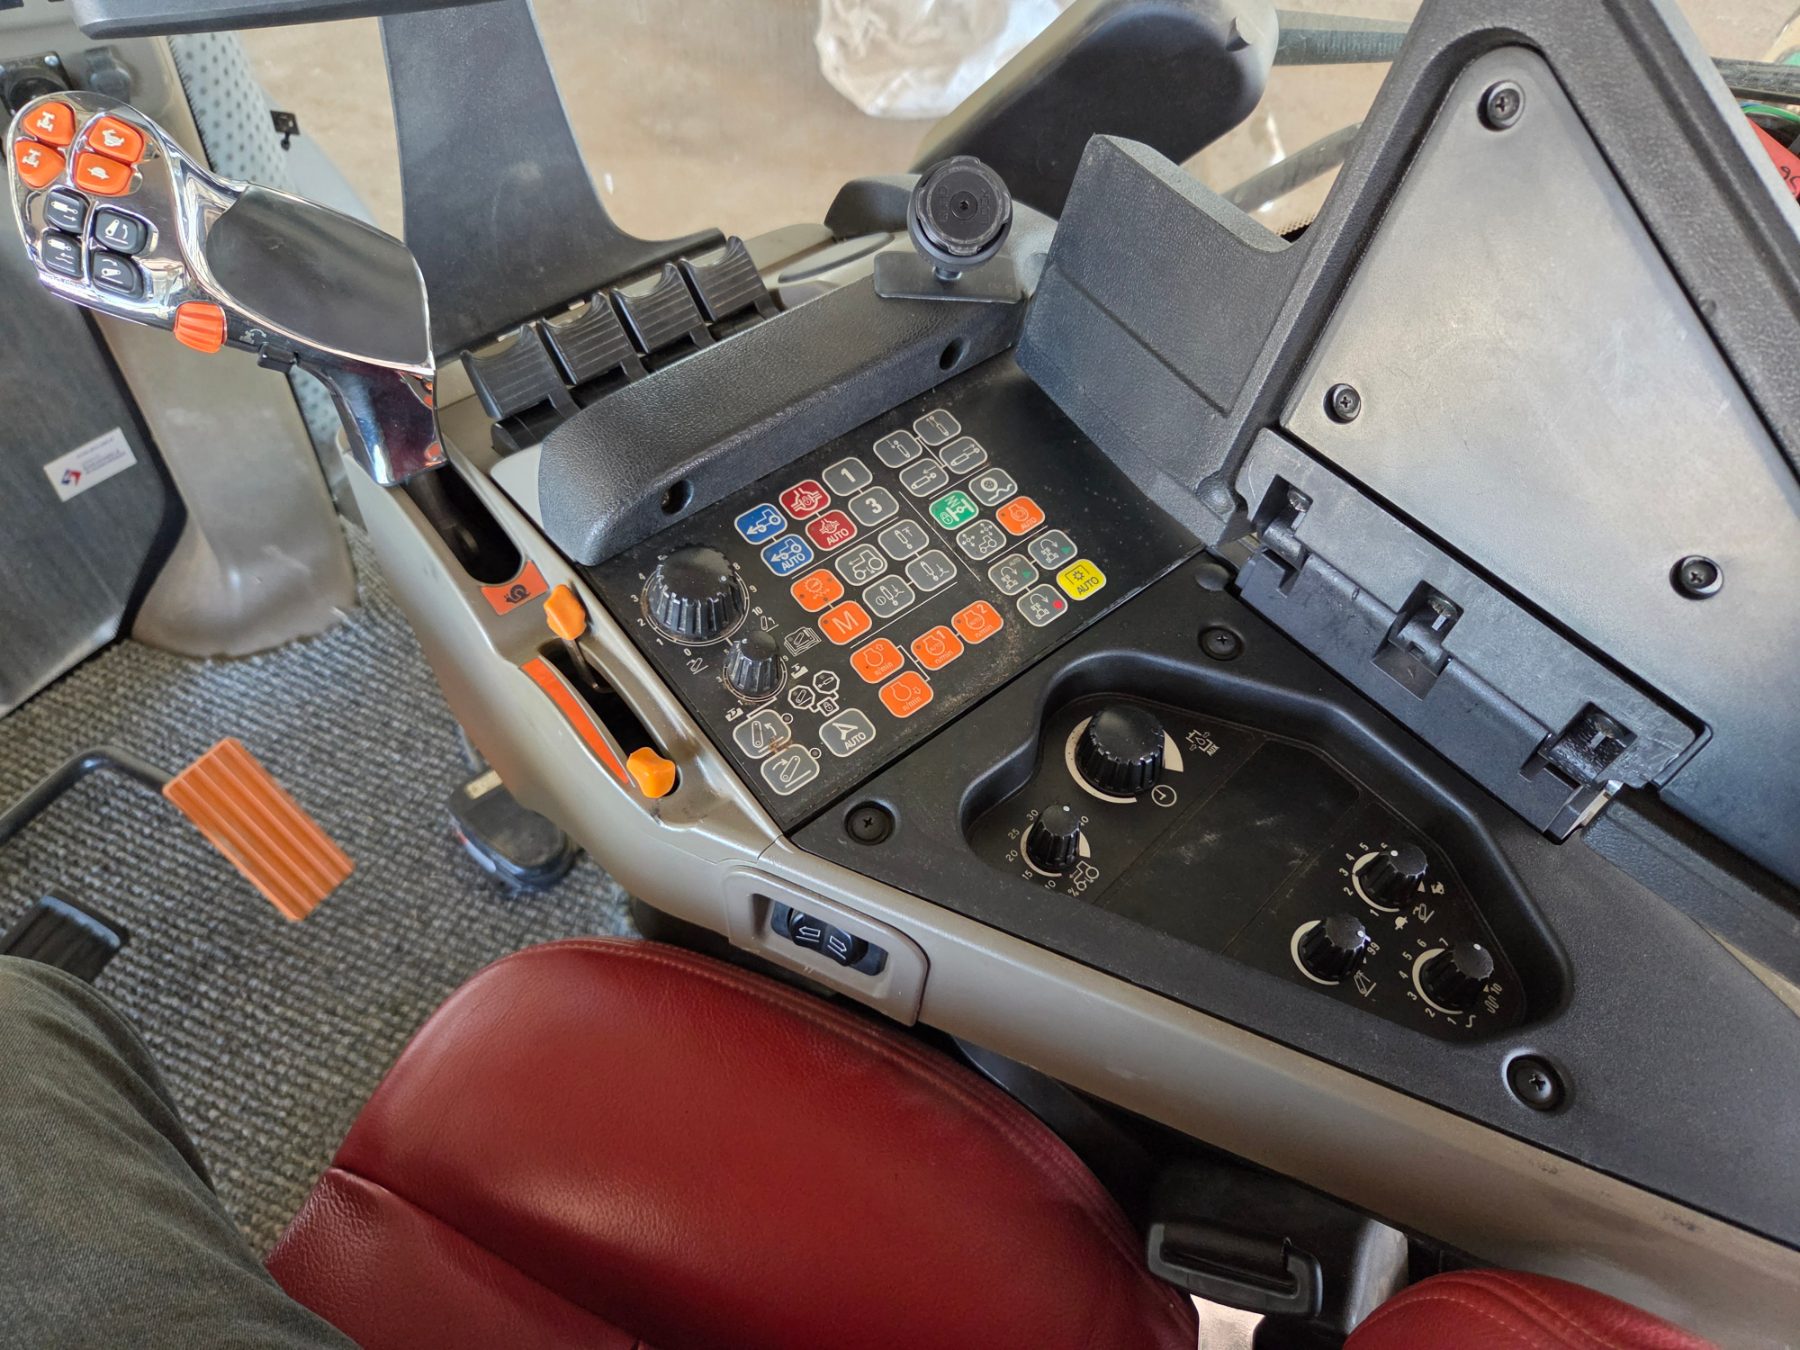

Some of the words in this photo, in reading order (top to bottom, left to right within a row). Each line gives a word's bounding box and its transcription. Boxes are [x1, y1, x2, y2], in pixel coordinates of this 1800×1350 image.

[841, 468, 856, 482] 1
[866, 498, 882, 514] 3
[1021, 516, 1037, 530] AUTO
[826, 528, 849, 546] AUTO
[732, 562, 741, 570] 8
[781, 553, 805, 572] AUTO
[748, 585, 758, 593] 9
[1077, 576, 1099, 594] AUTO
[630, 594, 639, 602] 3
[752, 606, 763, 616] 10
[977, 604, 988, 614] 2
[637, 618, 646, 627] 2
[832, 610, 859, 634] M
[936, 630, 945, 639] 1
[656, 638, 664, 646] 1
[683, 648, 692, 656] 0
[845, 732, 866, 750] AUTO
[1026, 809, 1039, 821] 30
[1008, 828, 1020, 839] 25
[1359, 842, 1369, 851] 5
[1005, 850, 1018, 862] 20
[1345, 853, 1355, 861] 4
[1022, 870, 1033, 880] 15
[1339, 868, 1349, 876] 3
[1044, 880, 1056, 890] 10
[1068, 887, 1079, 897] %
[1343, 887, 1354, 896] 2
[1370, 909, 1380, 917] 1
[1416, 938, 1427, 948] 6
[1439, 937, 1449, 946] 7
[1367, 942, 1380, 956] 99
[1402, 951, 1412, 961] 5
[1398, 970, 1409, 980] 4
[1491, 983, 1503, 995] 10
[1407, 991, 1418, 1000] 3
[1424, 1008, 1436, 1018] 2
[1447, 1016, 1457, 1025] 1
